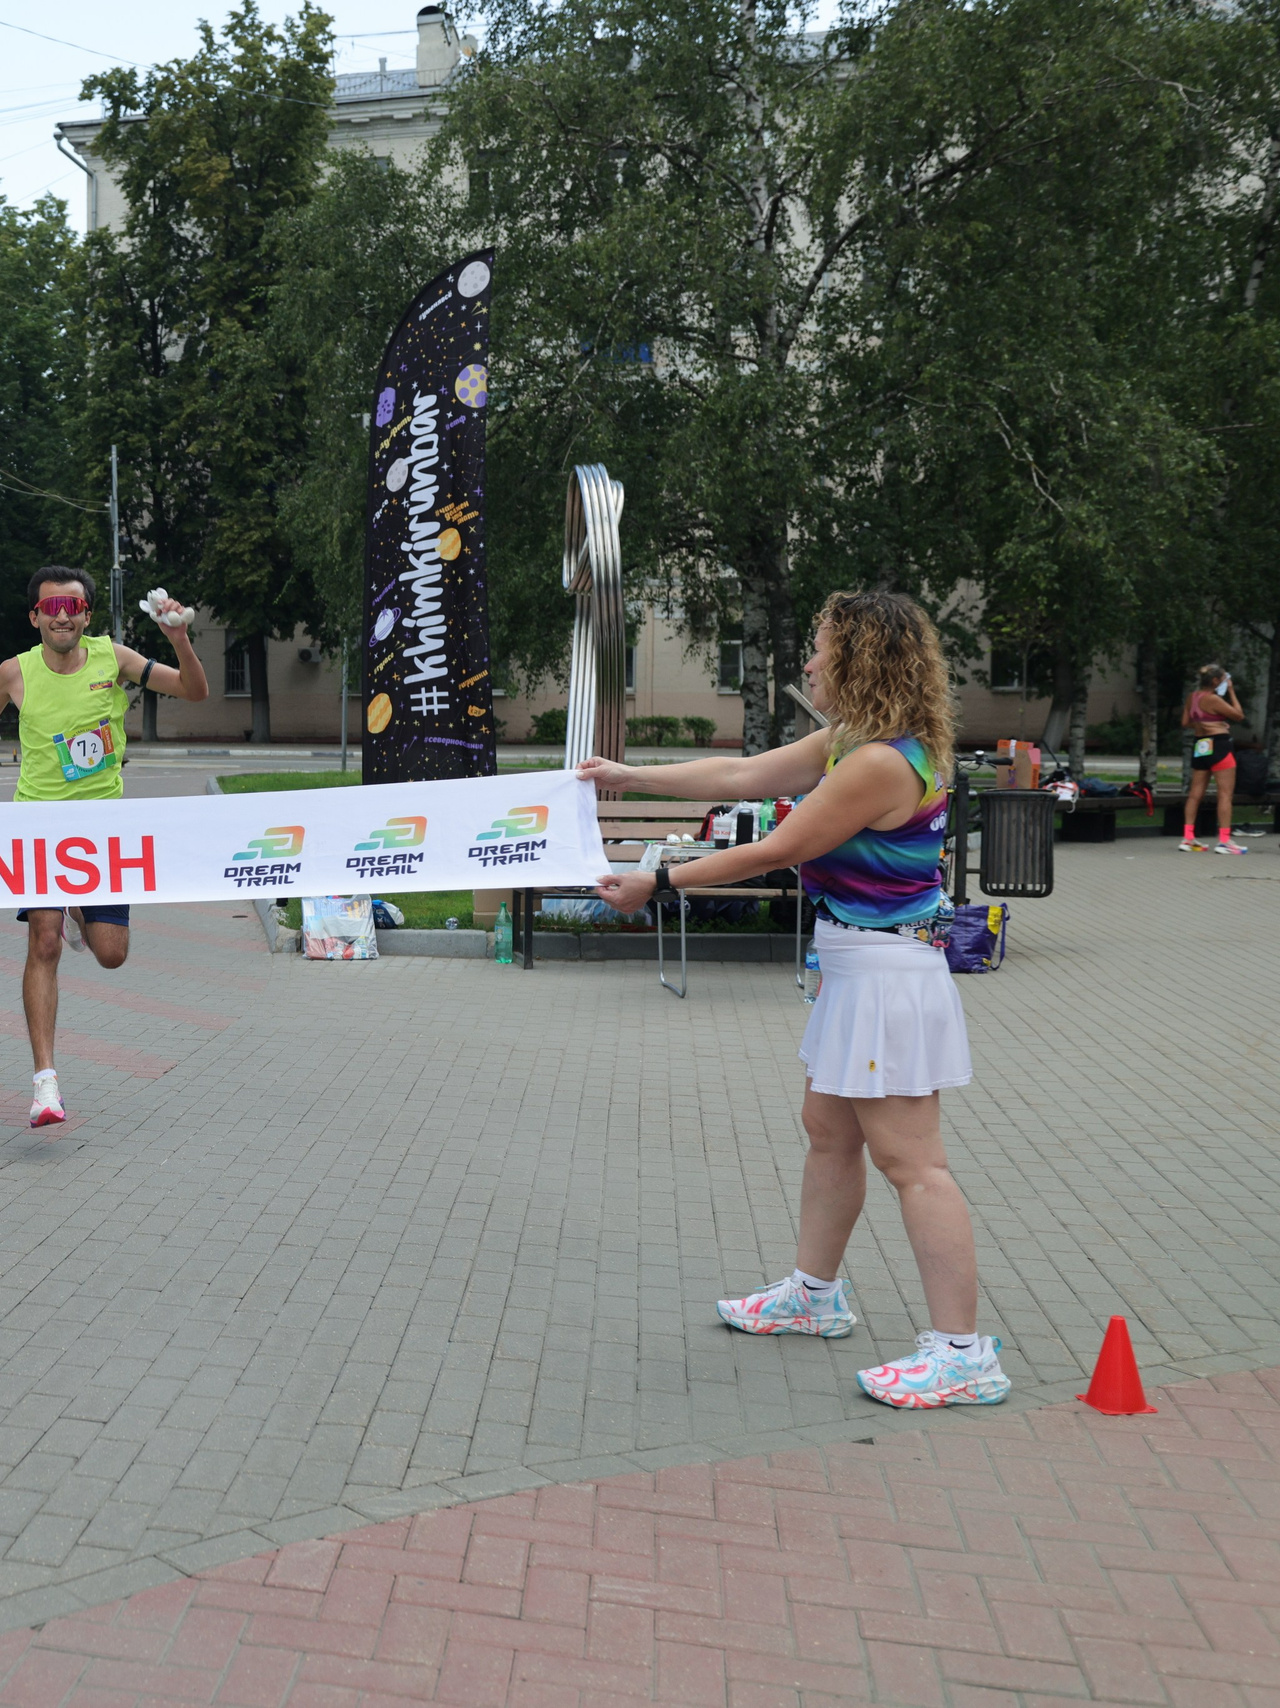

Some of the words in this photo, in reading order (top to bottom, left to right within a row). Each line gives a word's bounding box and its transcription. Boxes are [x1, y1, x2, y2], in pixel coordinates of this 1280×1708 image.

[398, 389, 451, 717] #khimkirunbar
[76, 739, 87, 758] 7
[90, 742, 99, 754] 2
[468, 839, 548, 858] DREAM
[346, 852, 424, 868] DREAM
[478, 852, 541, 868] TRAIL
[224, 862, 302, 878] DREAM
[355, 864, 418, 879] TRAIL
[233, 875, 294, 888] TRAIL
